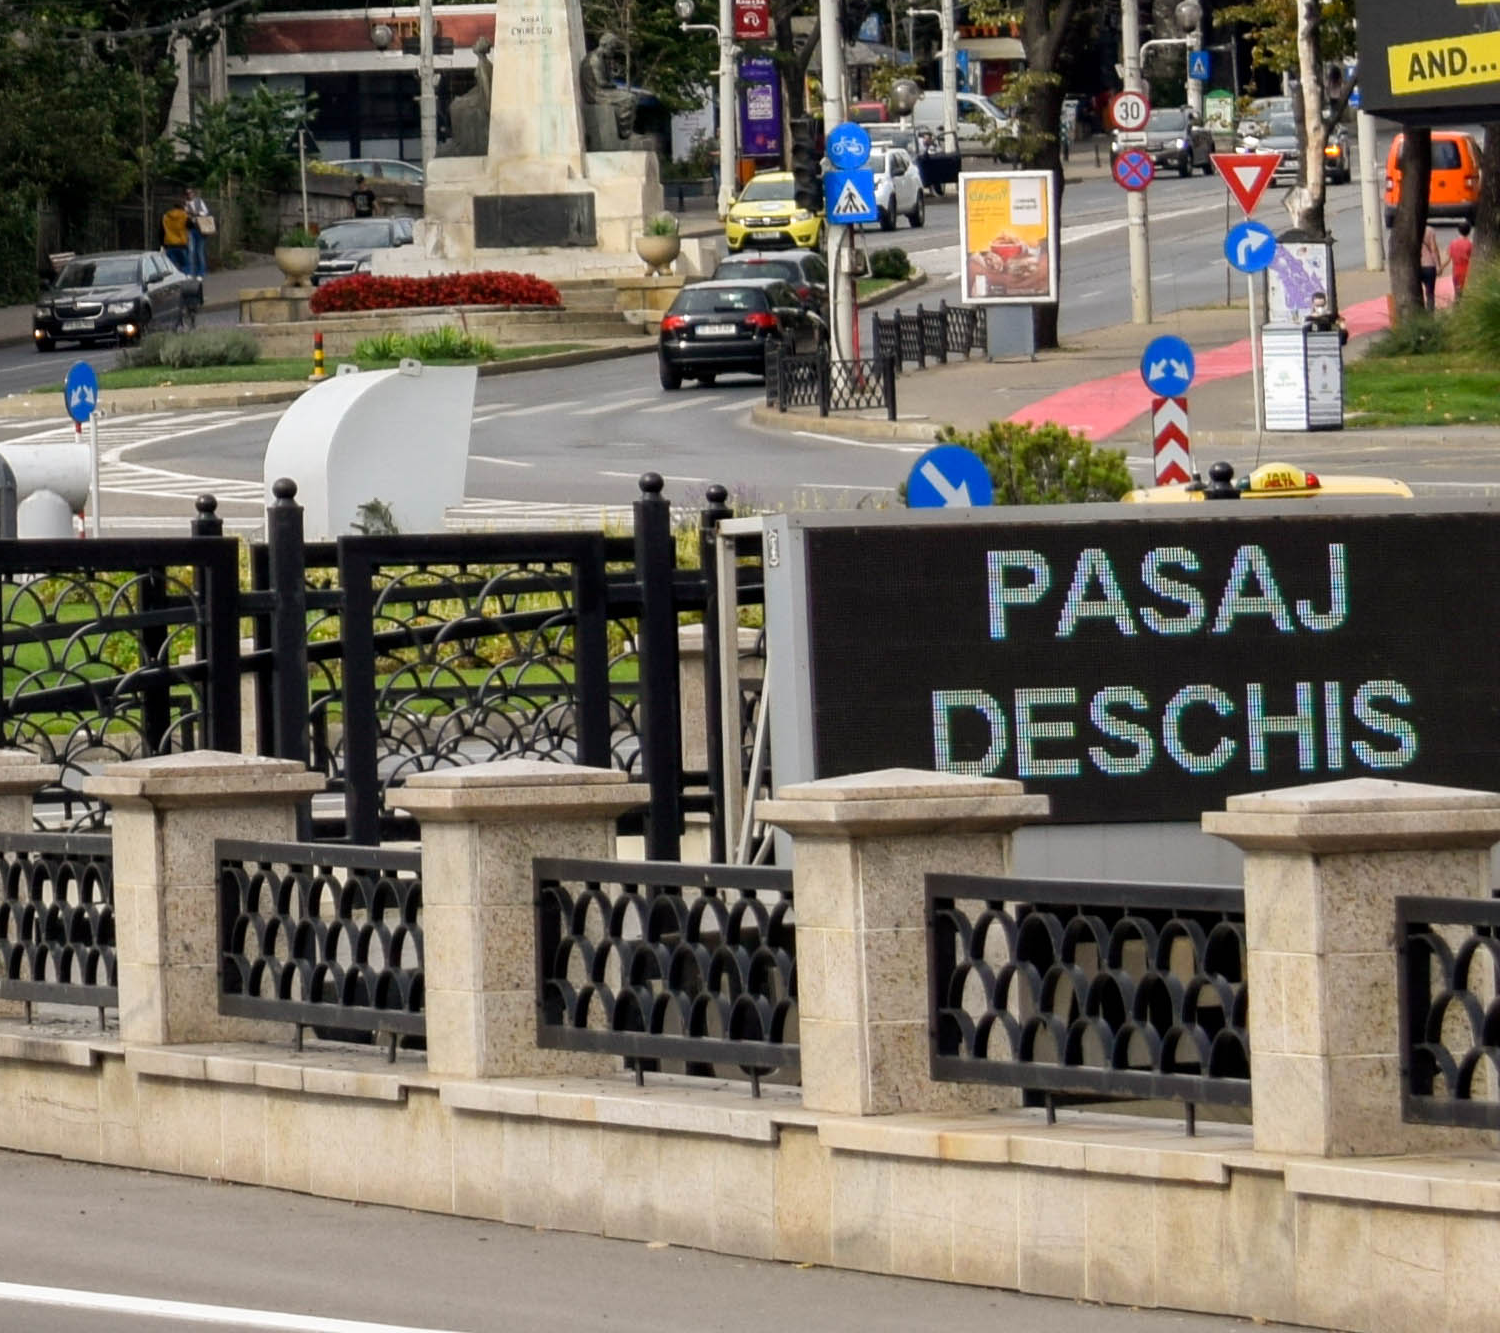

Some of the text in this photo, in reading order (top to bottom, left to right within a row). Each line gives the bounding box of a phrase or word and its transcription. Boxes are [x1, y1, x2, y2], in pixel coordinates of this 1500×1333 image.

[1408, 46, 1498, 83] AND...
[1120, 101, 1140, 121] 30
[987, 543, 1348, 639] PASAJ
[932, 680, 1418, 777] DESCHIS
